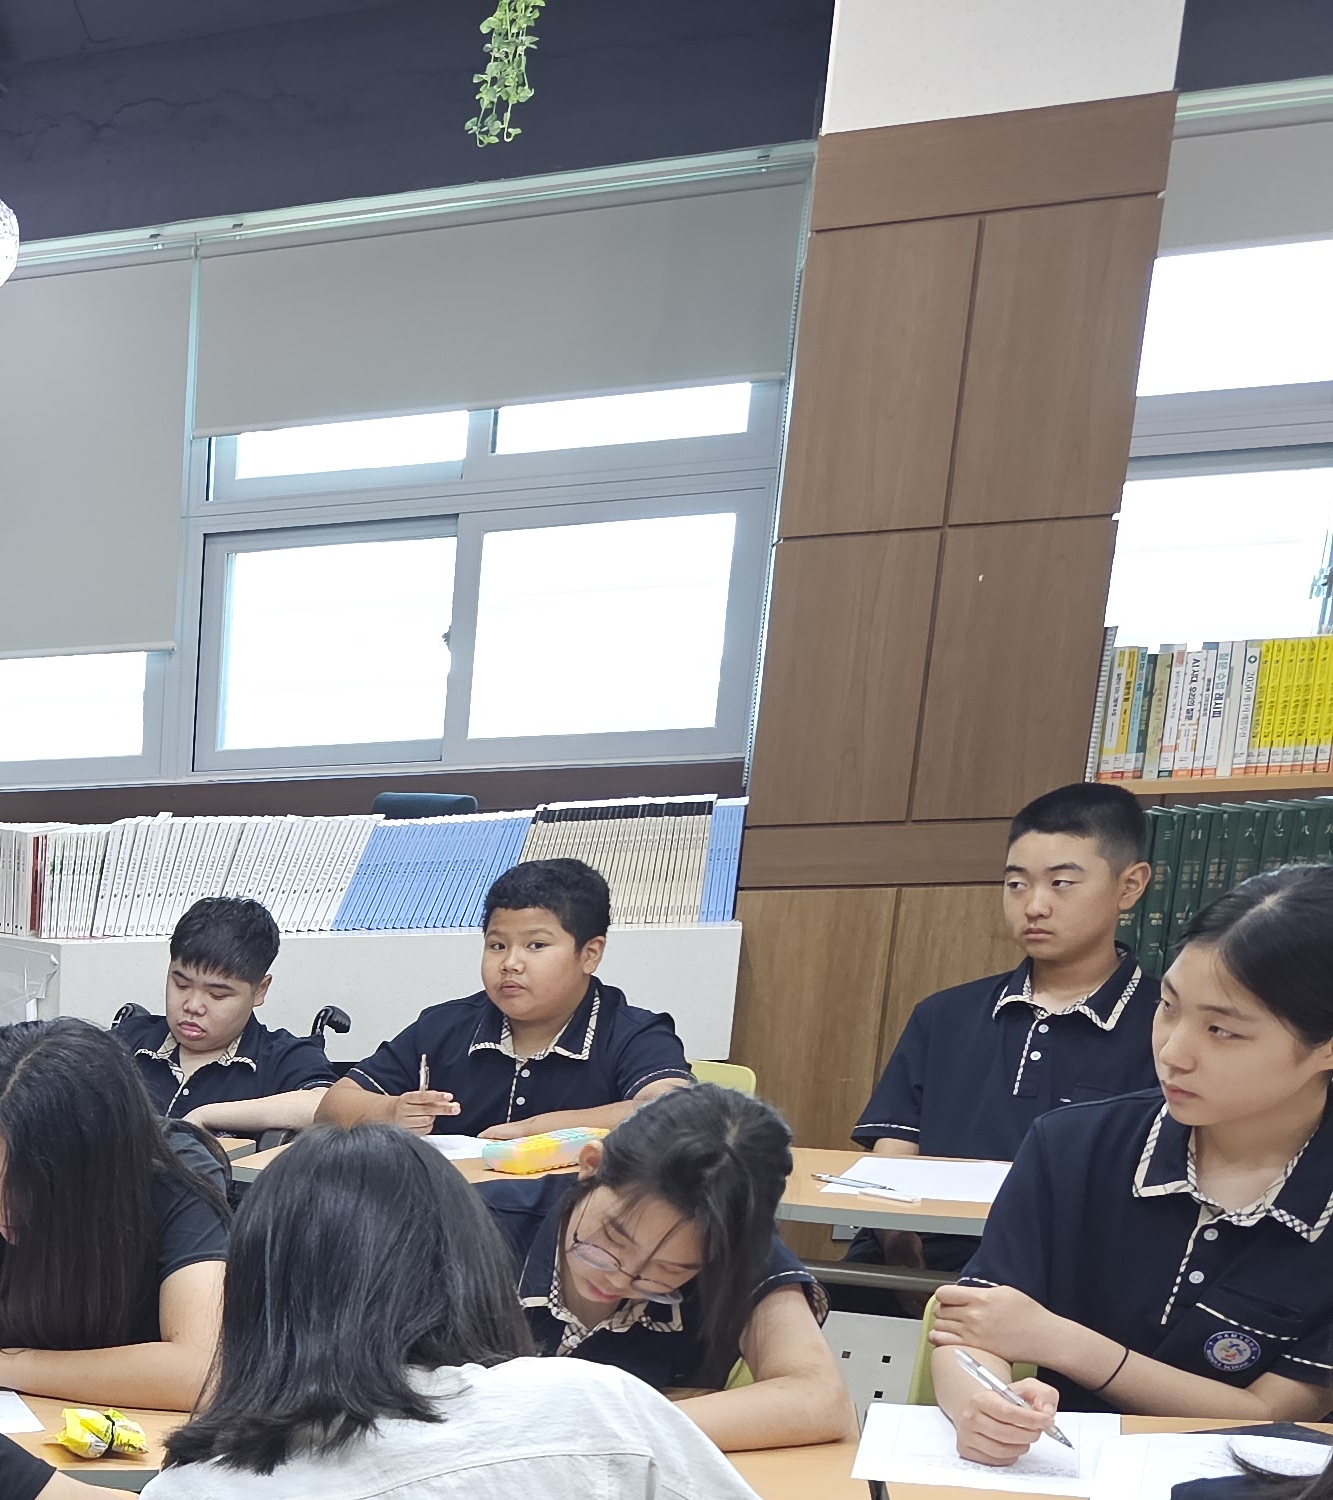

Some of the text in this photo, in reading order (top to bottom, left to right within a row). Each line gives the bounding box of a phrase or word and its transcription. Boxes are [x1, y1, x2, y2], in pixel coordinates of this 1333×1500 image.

[1190, 657, 1200, 669] AI
[1215, 671, 1226, 690] 수업
[1243, 670, 1255, 693] 2050
[1186, 685, 1197, 707] 우리의
[1211, 692, 1224, 719] 레시피
[1184, 707, 1195, 721] 질문
